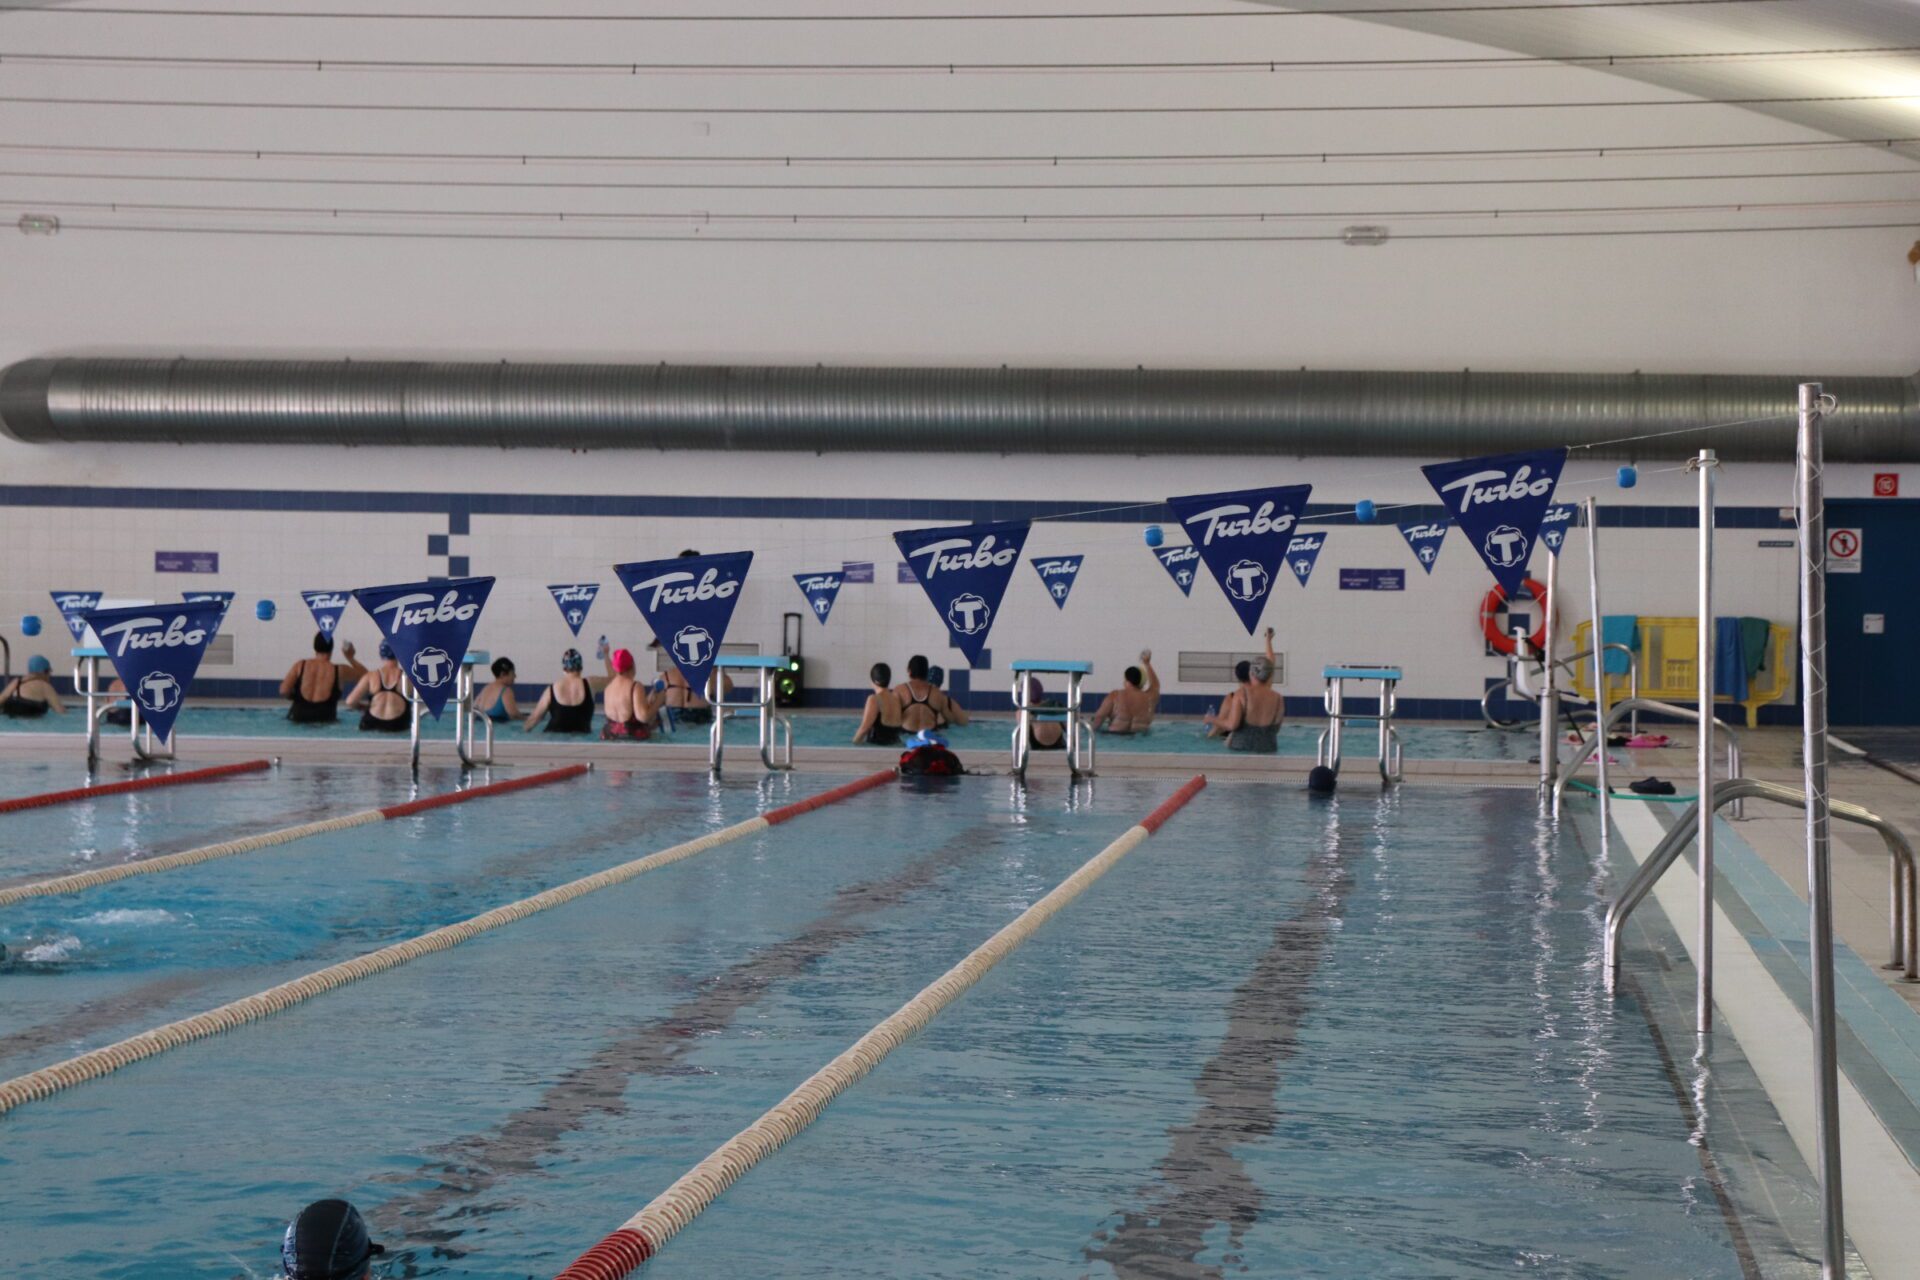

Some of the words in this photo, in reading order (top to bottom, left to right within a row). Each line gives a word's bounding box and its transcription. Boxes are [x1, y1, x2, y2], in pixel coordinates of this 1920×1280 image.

[1442, 465, 1553, 513] Turbo
[1186, 501, 1296, 545] Turbo
[1404, 523, 1446, 542] Turbo
[909, 535, 1016, 579] Turbo
[1160, 546, 1200, 566] Turbo
[1491, 533, 1521, 561] T
[1037, 560, 1078, 577] Turbo
[1231, 568, 1261, 596] T
[554, 584, 595, 604] Turbo
[632, 567, 739, 613] Turbo
[799, 575, 841, 593] Turbo
[56, 595, 98, 610] Turbo
[305, 595, 347, 610] Turbo
[373, 590, 479, 635] Turbo
[954, 600, 983, 629] T
[101, 615, 206, 657] Turbo
[678, 632, 707, 661] T
[420, 654, 448, 682] T
[145, 679, 175, 707] T
